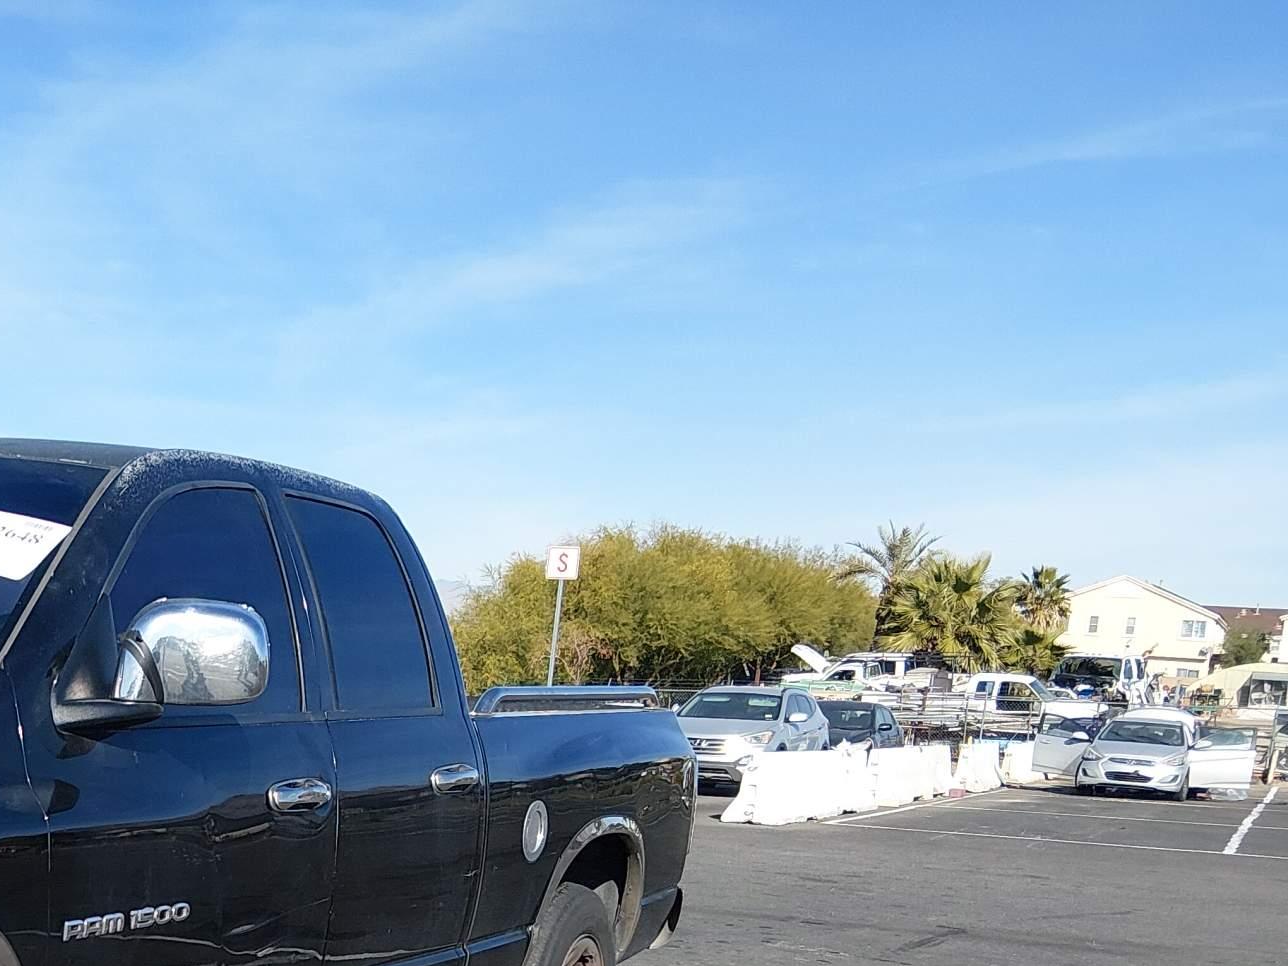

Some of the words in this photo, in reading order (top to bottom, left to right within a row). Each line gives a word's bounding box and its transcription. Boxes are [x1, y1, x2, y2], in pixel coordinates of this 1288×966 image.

[557, 552, 569, 573] S
[63, 912, 125, 942] RAM
[130, 902, 191, 930] 1500
